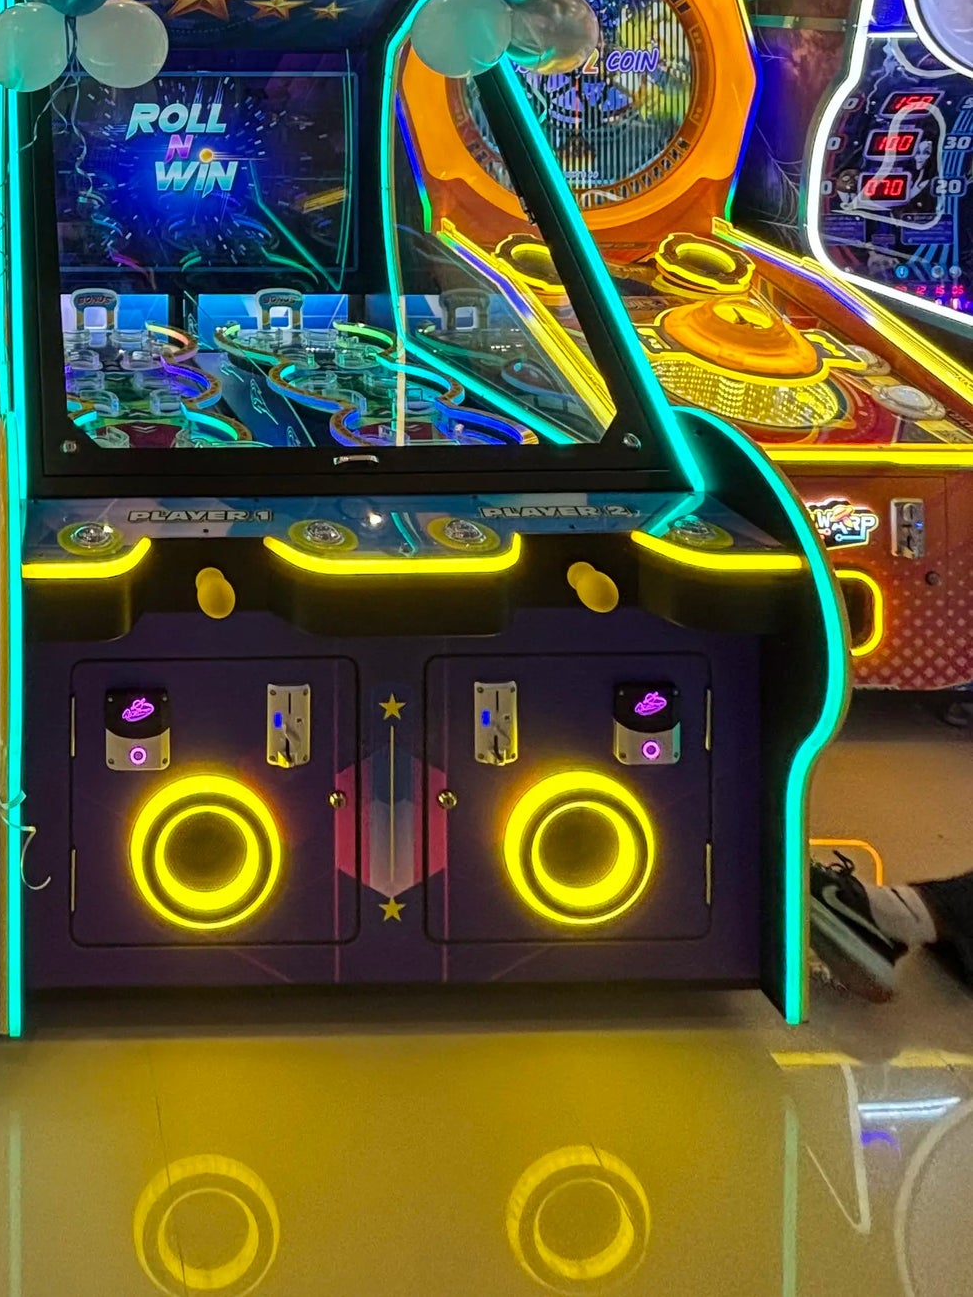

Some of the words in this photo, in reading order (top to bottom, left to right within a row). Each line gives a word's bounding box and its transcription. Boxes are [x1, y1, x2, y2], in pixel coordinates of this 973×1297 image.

[605, 48, 660, 73] COIN
[125, 102, 227, 141] ROLL
[164, 133, 194, 164] N
[878, 135, 914, 151] 100
[944, 136, 972, 150] 30
[154, 160, 239, 199] WIN
[935, 180, 962, 194] 20
[129, 510, 248, 522] PLAYER
[256, 510, 270, 522] 1
[482, 507, 600, 520] PLAYER
